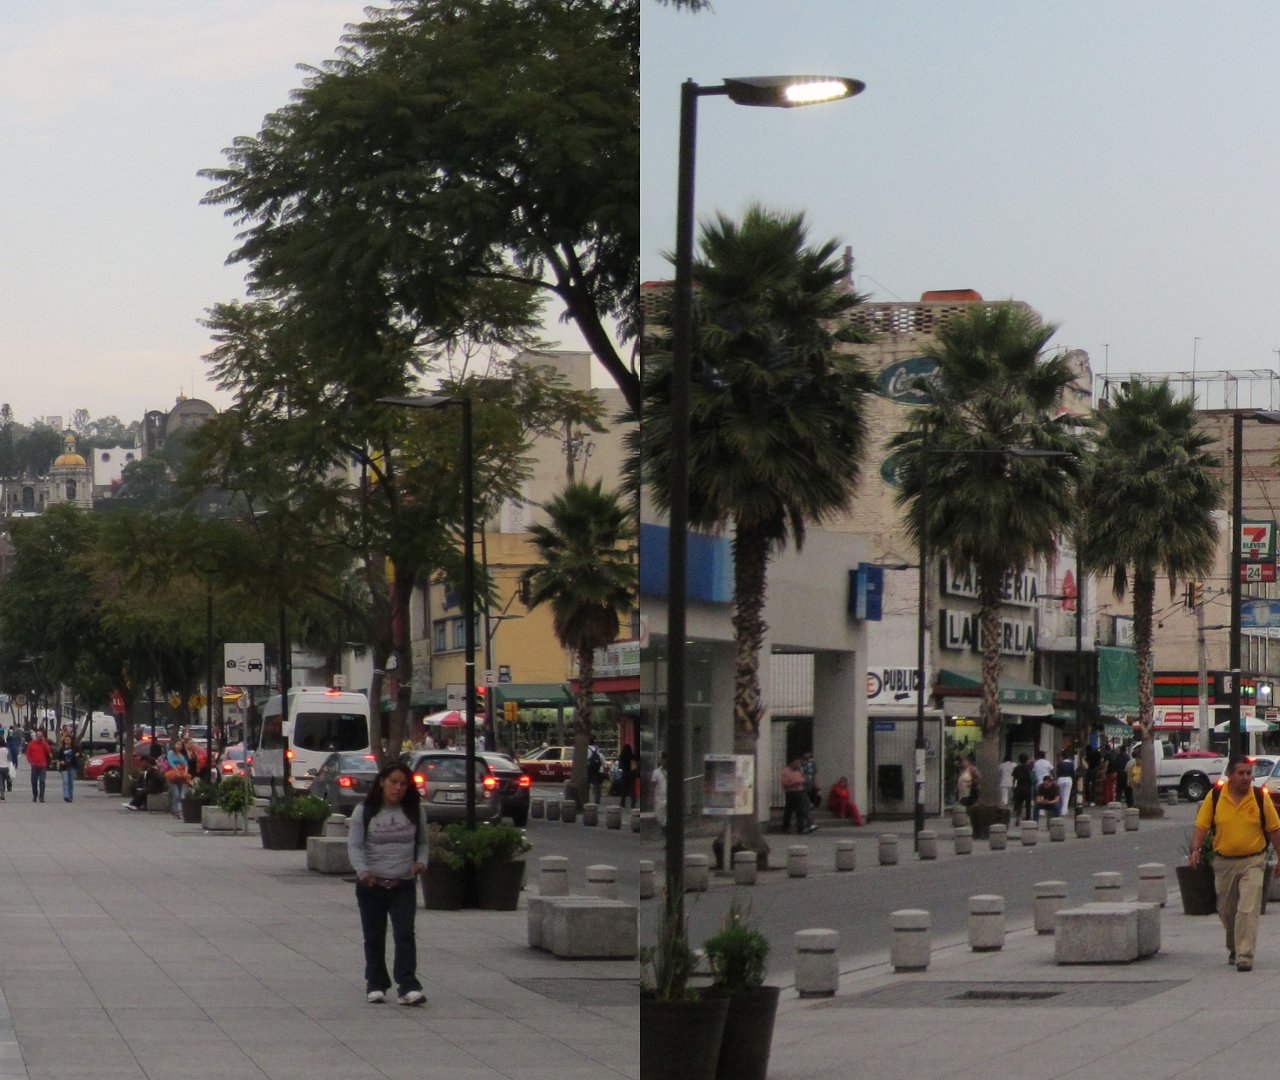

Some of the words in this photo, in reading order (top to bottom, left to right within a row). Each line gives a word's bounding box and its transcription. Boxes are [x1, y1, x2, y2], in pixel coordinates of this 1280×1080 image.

[1247, 567, 1260, 578] 24
[949, 615, 973, 647] LA
[883, 669, 925, 693] PUBLIC
